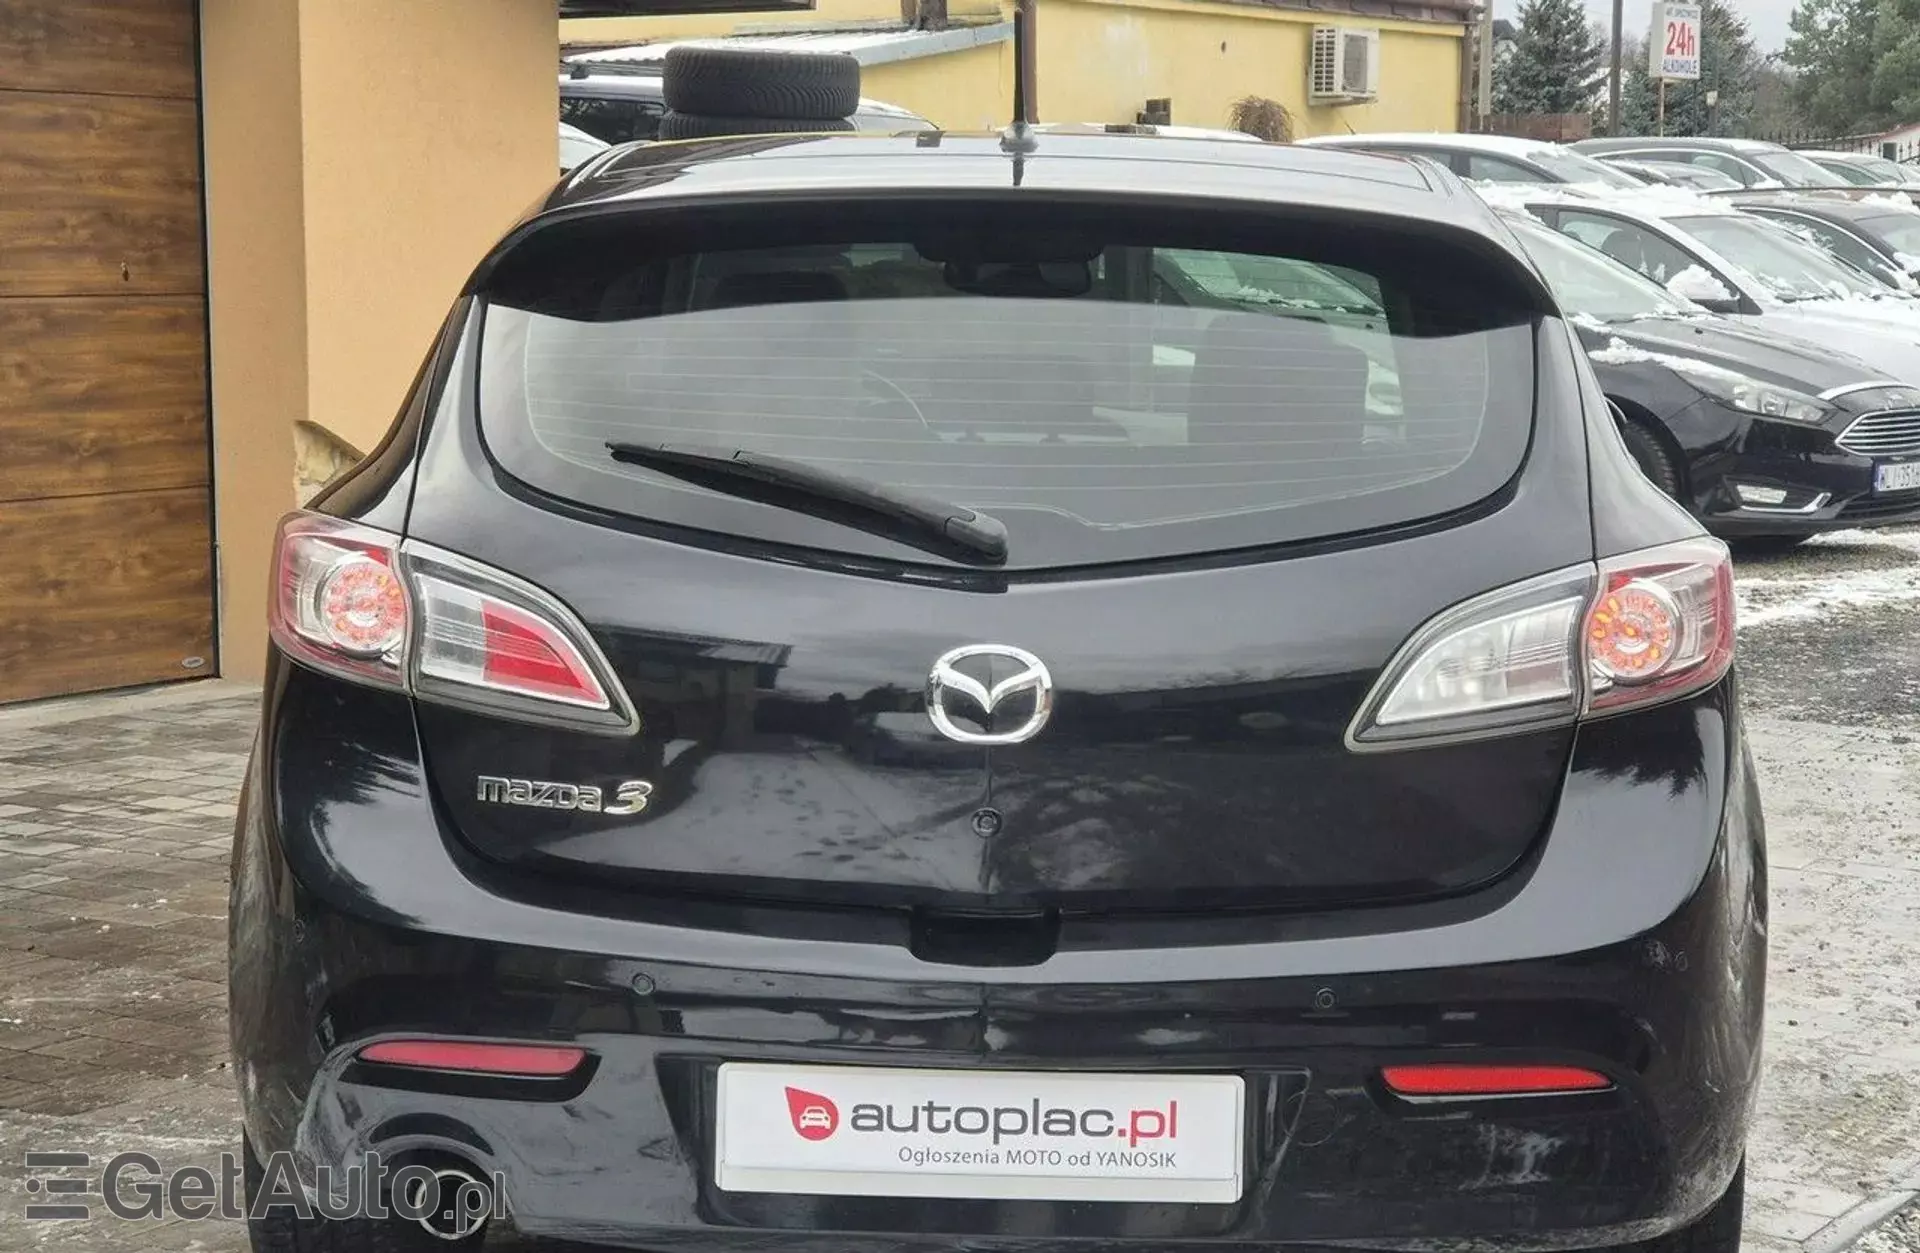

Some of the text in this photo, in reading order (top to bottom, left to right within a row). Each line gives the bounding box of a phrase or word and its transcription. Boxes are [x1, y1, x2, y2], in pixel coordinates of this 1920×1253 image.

[1666, 21, 1695, 57] 24h
[604, 780, 653, 814] 3
[850, 1098, 1177, 1147] autoplac.pl
[898, 1146, 1176, 1168] Ogłoszenia MOTO od YANOSIK
